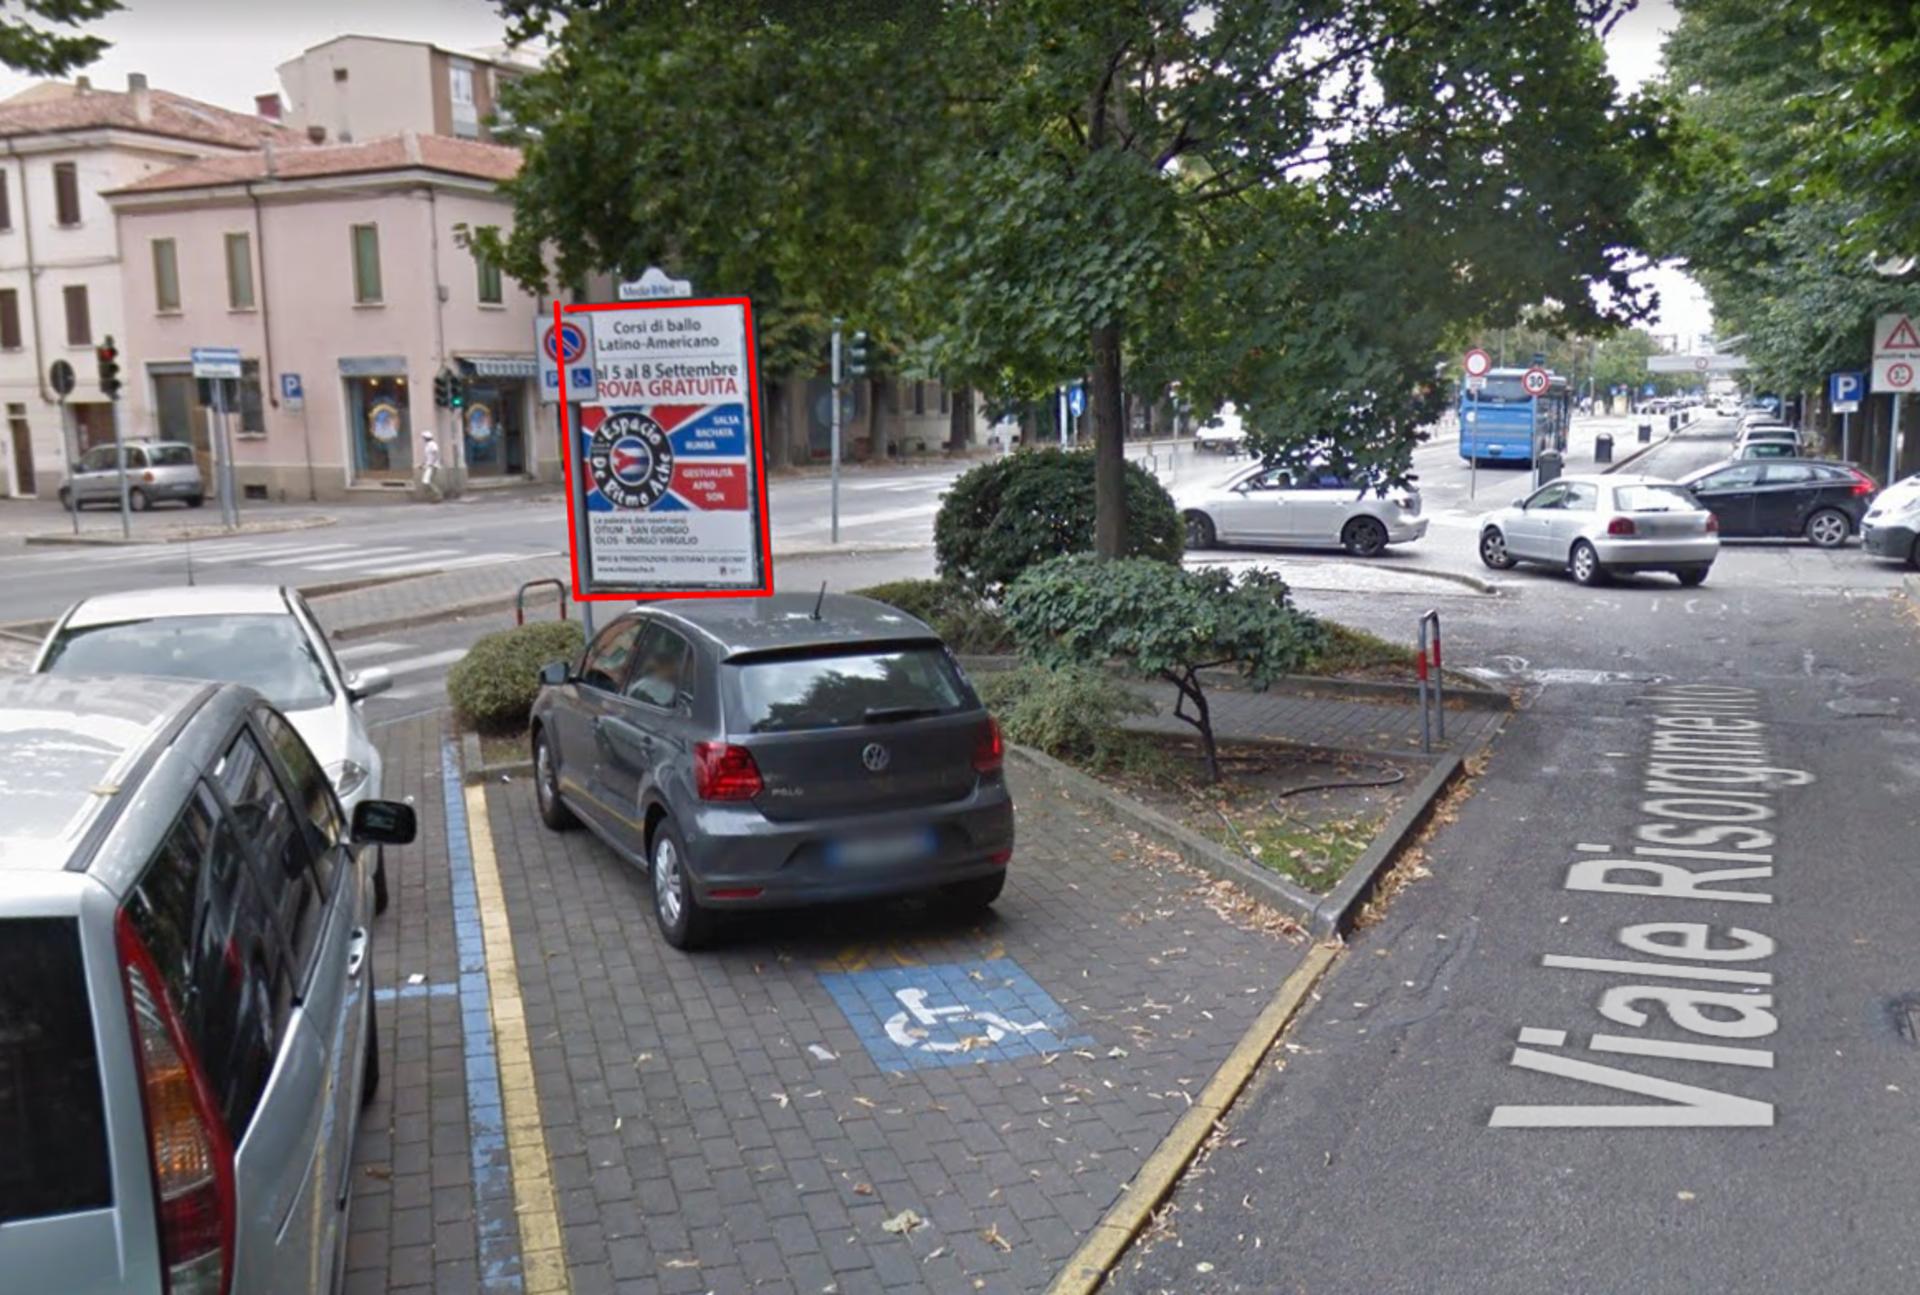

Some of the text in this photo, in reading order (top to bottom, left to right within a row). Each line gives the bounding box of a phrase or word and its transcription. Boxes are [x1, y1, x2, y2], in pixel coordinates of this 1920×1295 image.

[613, 318, 702, 335] Corsi di ballo
[598, 336, 720, 351] Latino-Americano
[596, 361, 738, 379] al 5 al 8 Settembre
[284, 377, 298, 395] P
[597, 378, 738, 398] ROVA GRATUITA
[1529, 375, 1543, 388] 30
[1837, 376, 1857, 399] P
[713, 415, 740, 425] SALSA
[600, 418, 661, 445] Espacio
[695, 428, 734, 438] BACHATA
[685, 440, 717, 450] RUMBA
[592, 457, 607, 479] De
[603, 479, 649, 507] Ritmo
[692, 480, 717, 490] AFRO
[705, 492, 725, 502] SON
[594, 526, 623, 535] OTIUM
[631, 526, 649, 535] SAN
[651, 526, 689, 535] GIORGIO
[626, 536, 657, 545] BORGO
[660, 536, 698, 545] VIRGILIO
